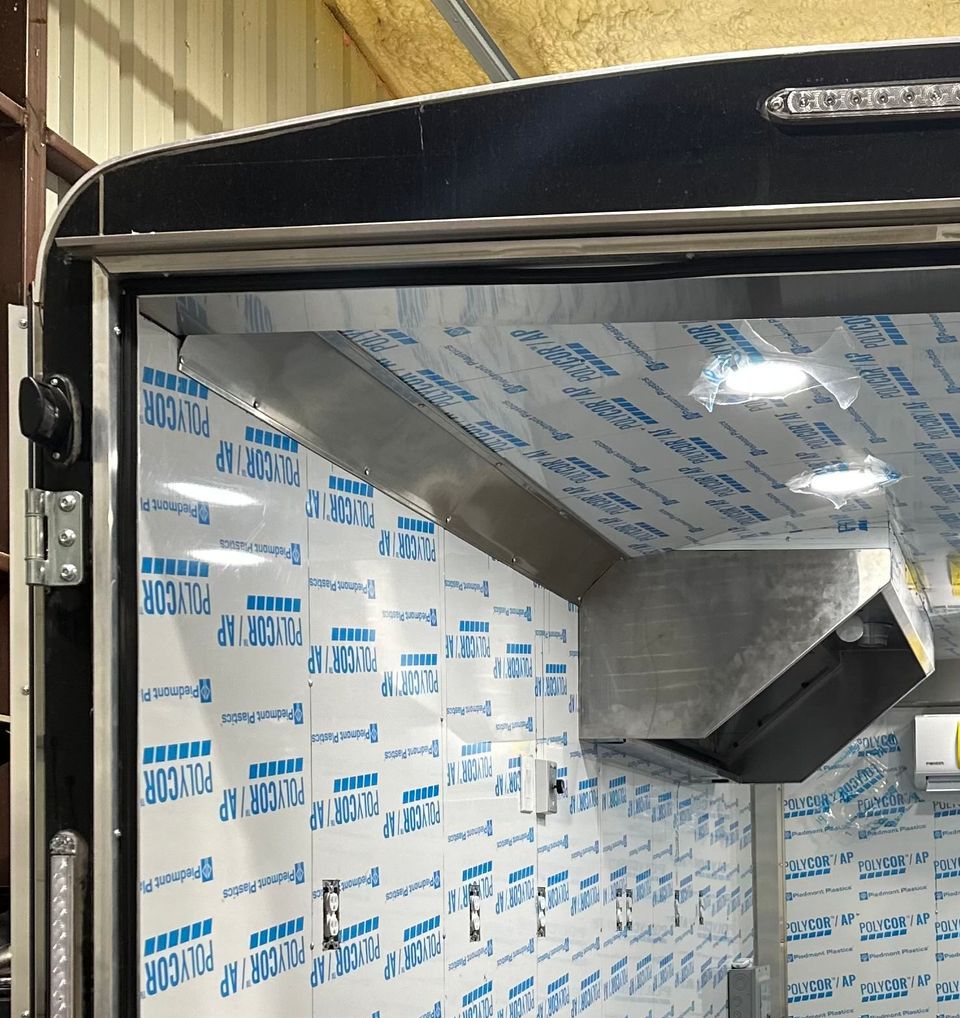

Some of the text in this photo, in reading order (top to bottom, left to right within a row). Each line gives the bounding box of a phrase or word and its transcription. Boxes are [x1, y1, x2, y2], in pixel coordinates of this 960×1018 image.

[151, 684, 198, 701] Piedmont
[221, 708, 292, 726] Piedmont Plastics
[310, 728, 369, 746] Piedmont Plastics
[153, 865, 200, 891] Piedmont
[869, 950, 900, 959] Piedmont
